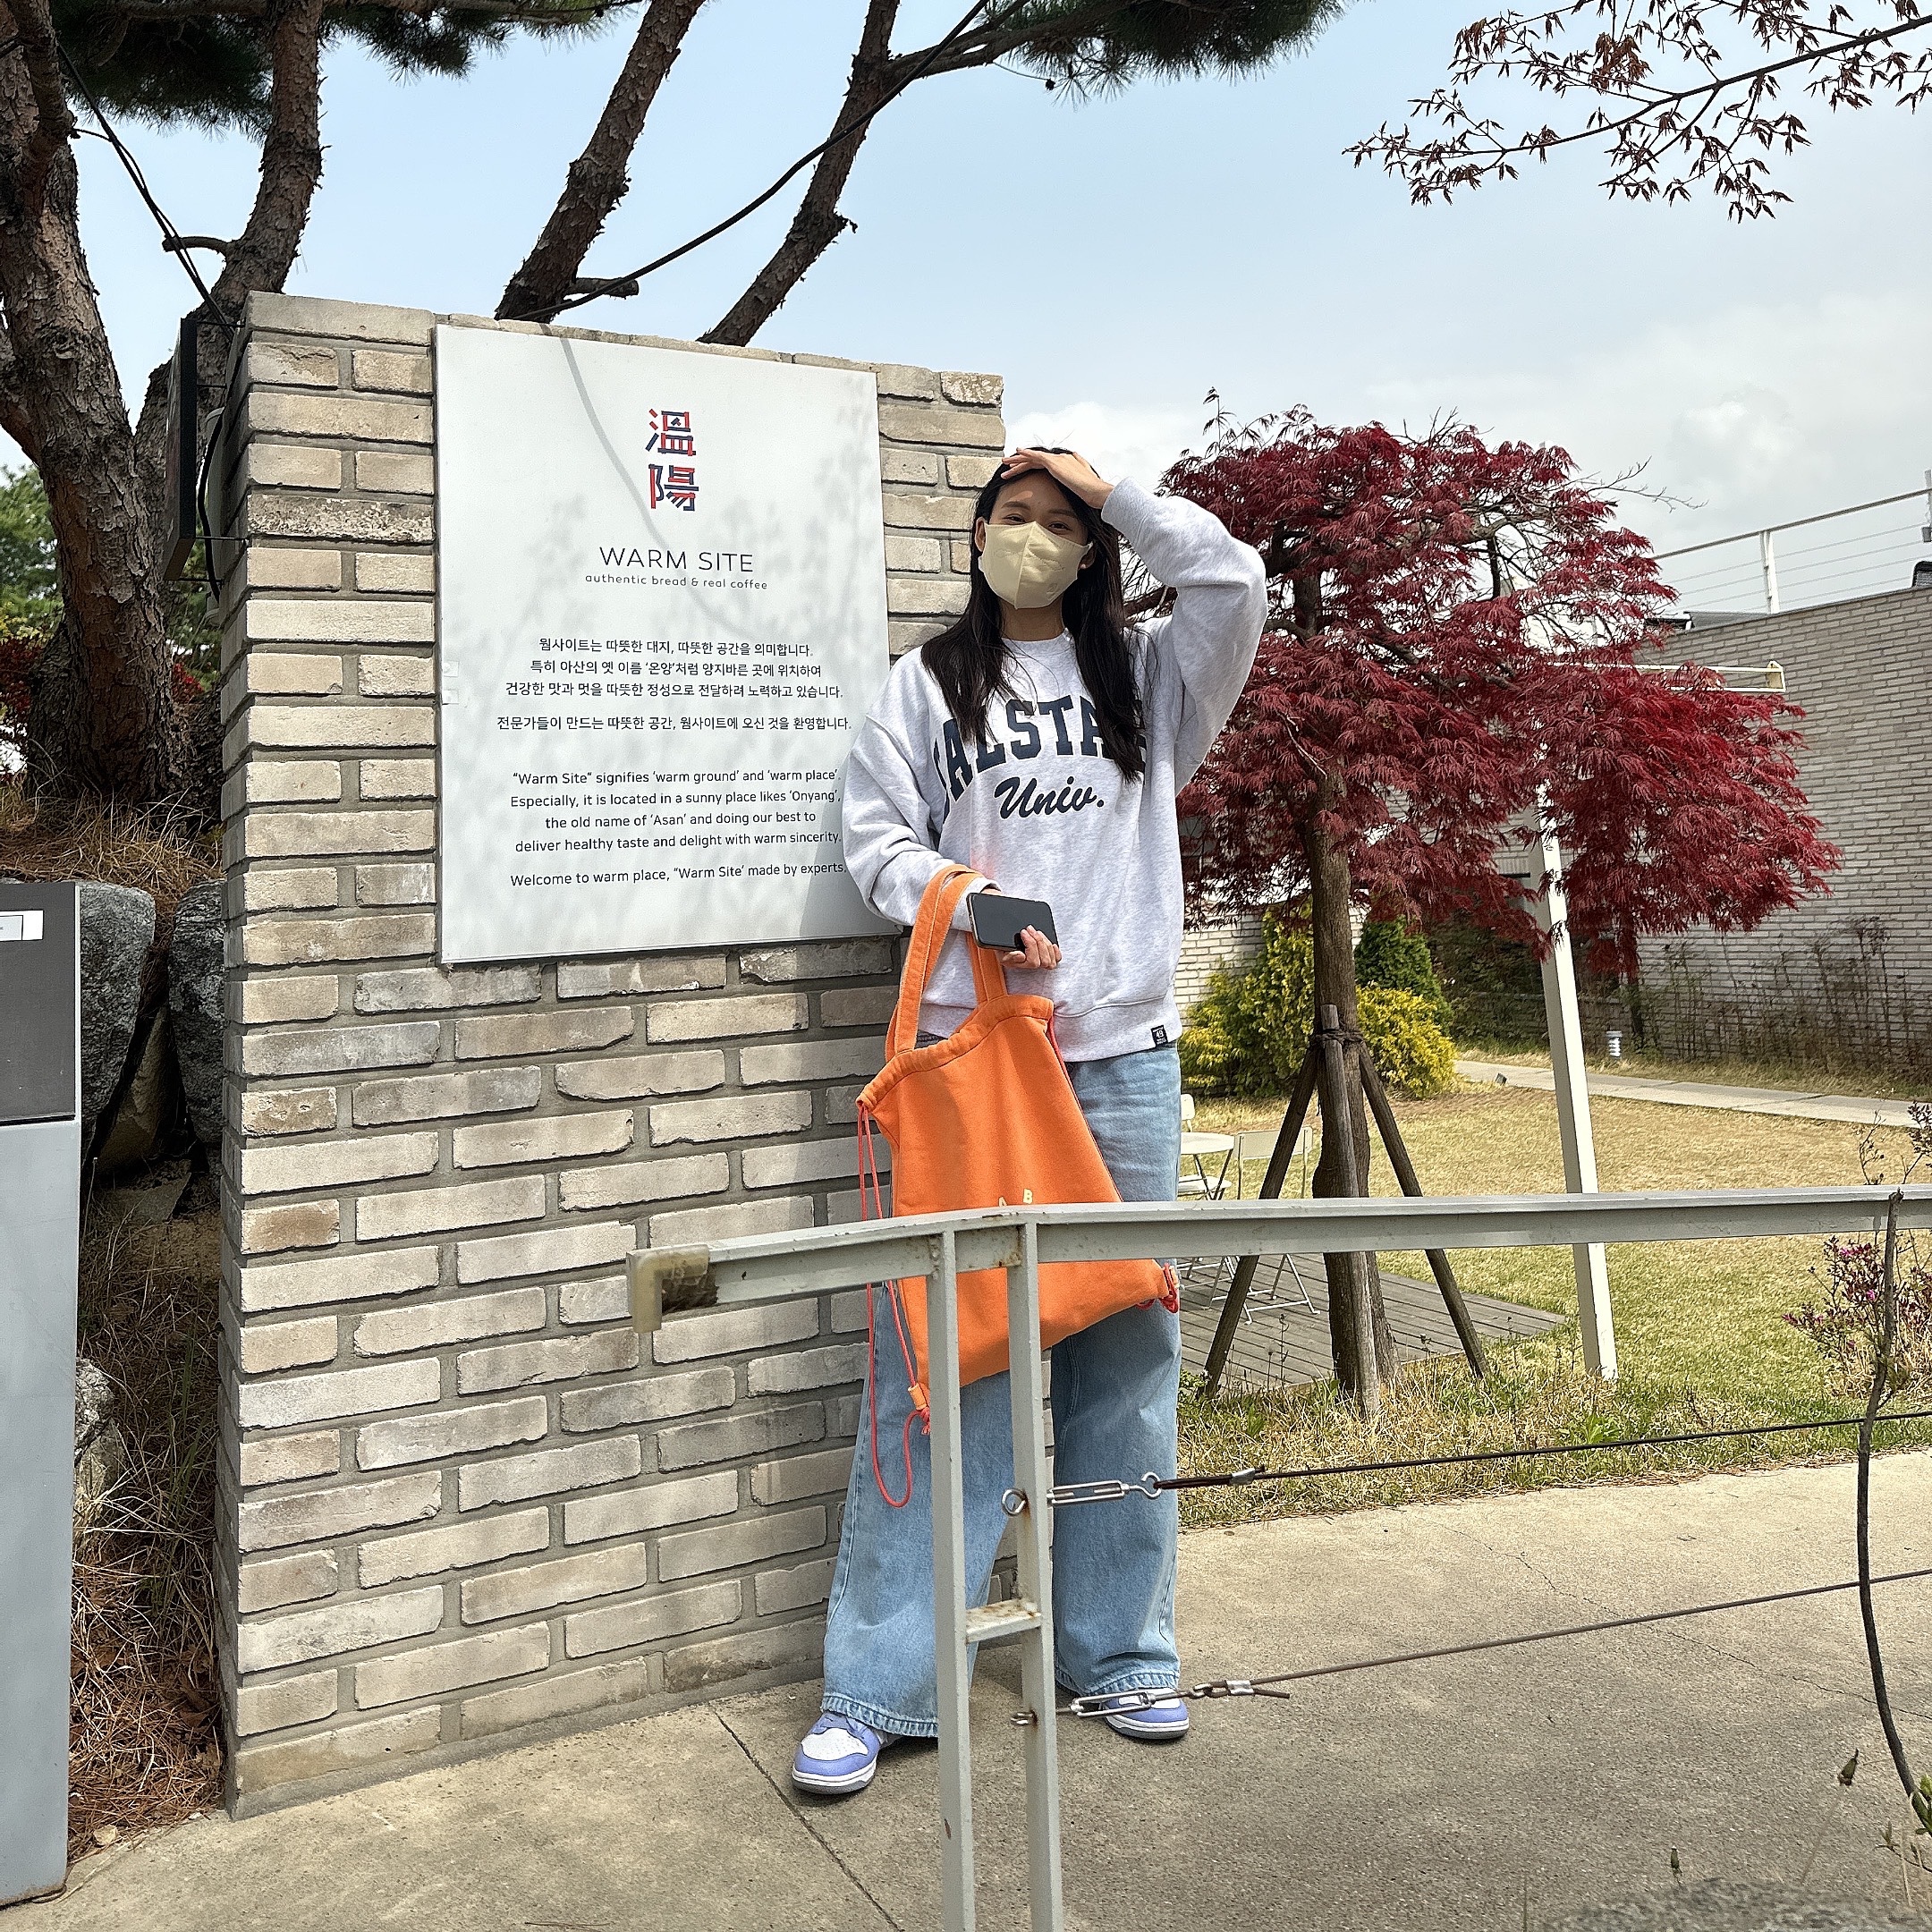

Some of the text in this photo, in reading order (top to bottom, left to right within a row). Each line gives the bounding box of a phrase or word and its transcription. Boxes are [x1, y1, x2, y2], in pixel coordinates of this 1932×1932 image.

[599, 546, 753, 572] WARM SITE
[586, 573, 767, 590] authentic bread & real coffee
[539, 638, 602, 652] 웜사이트는
[606, 640, 643, 653] 따뜻한
[647, 640, 674, 654] 대지,
[678, 641, 713, 654] 따뜻한
[716, 642, 750, 656] 공간을
[530, 660, 555, 674] 특히
[561, 660, 597, 674] 아산의
[602, 661, 614, 674] 옛
[618, 662, 642, 674] 이름
[703, 663, 749, 676] 양지바른
[751, 665, 774, 677] 곳에
[776, 663, 820, 678] 위치하여
[506, 682, 843, 699] 건강한 맛과 멋을 따뜻한 정성으로 전달하려 노력하고 있습니다.
[497, 716, 853, 730] 전문가들이 만드는 따뜻한 공간, 웜사이트에 오신 것을 환영합니다.
[597, 772, 649, 785] signifies
[743, 770, 764, 781] and
[512, 794, 579, 809] Especially,
[584, 794, 592, 805] it
[597, 794, 606, 805] is
[611, 792, 656, 804] located
[661, 792, 671, 803] in
[675, 795, 682, 803] a
[686, 794, 722, 805] sunny
[726, 792, 756, 805] place
[760, 791, 786, 803] likes
[994, 775, 1105, 819] Univ.
[546, 818, 566, 828] the
[572, 817, 590, 827] old
[596, 818, 630, 826] name
[634, 815, 647, 826] of
[691, 813, 712, 824] and
[716, 813, 749, 826] doing
[753, 813, 773, 822] our
[776, 812, 801, 822] best
[802, 810, 817, 823] to
[516, 830, 843, 852] deliver healthy taste and delight with warm sincerity.
[511, 873, 572, 887] Welcome
[576, 873, 589, 883] to
[593, 873, 628, 882] warm
[633, 869, 669, 884] place,
[747, 862, 780, 877] made
[783, 862, 799, 877] by
[800, 861, 848, 877] experts.
